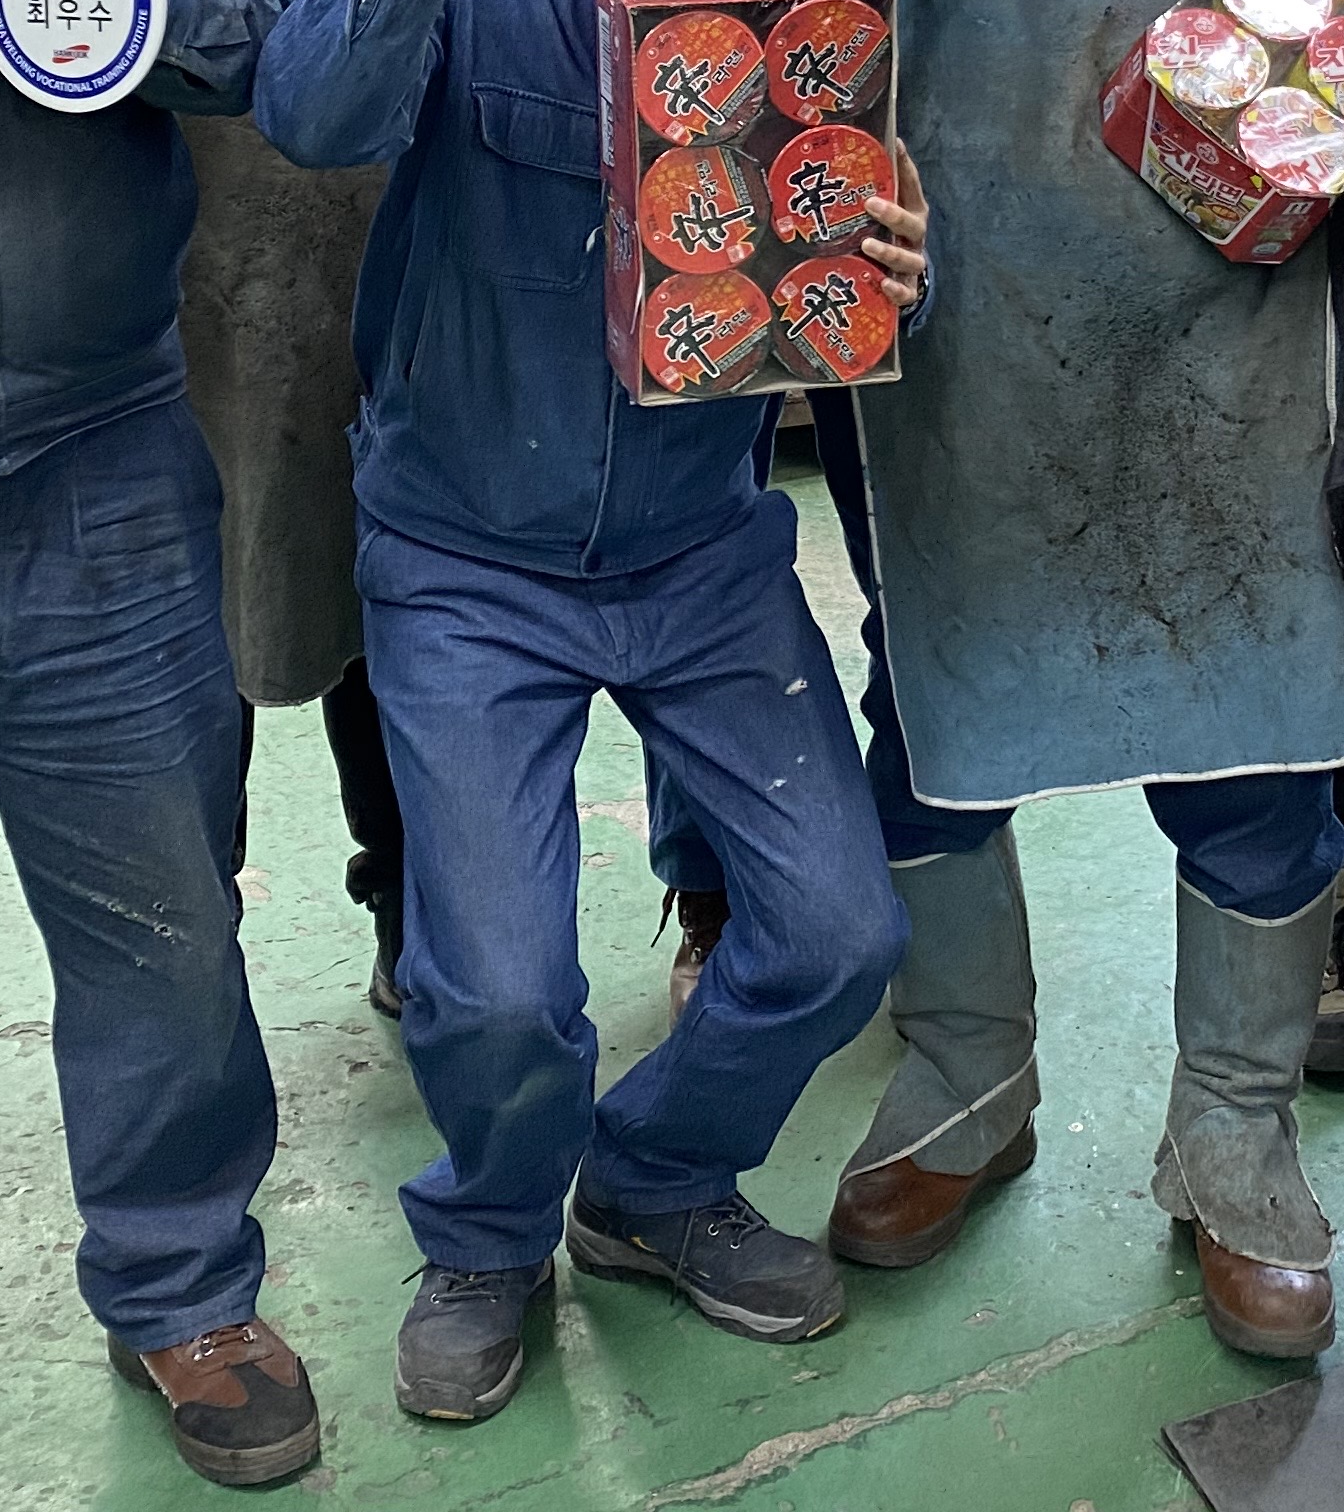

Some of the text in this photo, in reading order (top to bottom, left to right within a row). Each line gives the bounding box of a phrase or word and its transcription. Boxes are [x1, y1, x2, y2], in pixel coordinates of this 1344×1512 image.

[1, 37, 36, 77] WELDING
[36, 71, 93, 92] VOCATIONAL
[92, 58, 130, 89] TRAINING
[124, 8, 149, 61] INSTITUTE
[652, 49, 744, 126] 辛 라면
[782, 28, 870, 101] 辛 라면
[670, 159, 755, 255] 辛 라면
[787, 159, 877, 240] 辛 라면
[1157, 135, 1246, 207] 진라면
[658, 303, 751, 378] 辛 라면
[787, 272, 860, 363] 辛 라면
